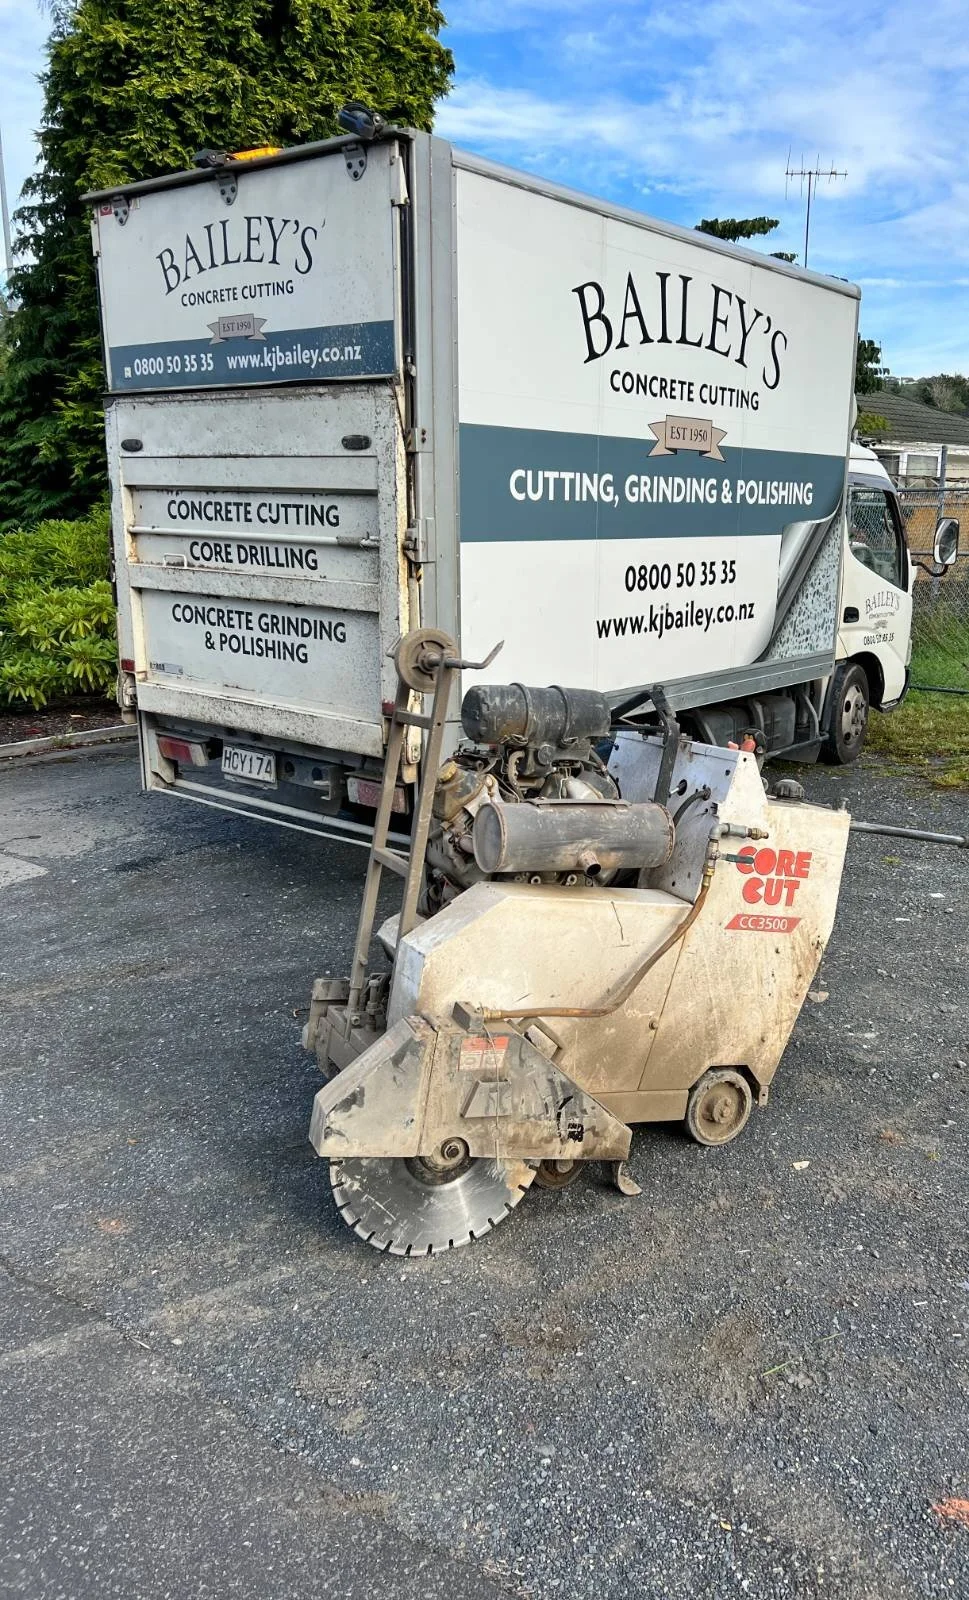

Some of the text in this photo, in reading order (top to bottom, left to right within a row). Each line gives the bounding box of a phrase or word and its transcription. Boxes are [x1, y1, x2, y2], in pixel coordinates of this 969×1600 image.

[156, 216, 318, 296] BAILEY'S
[181, 279, 294, 307] CONCRETE CUTTING
[222, 320, 252, 333] EST 1950
[572, 271, 788, 390] BAILEY'S
[134, 353, 214, 376] 0800 50 35 35
[227, 344, 362, 371] www.kjbailey.co.nz
[610, 369, 760, 411] CONCRETE CUTTING
[670, 425, 708, 443] EST 1950
[509, 469, 814, 508] CUTTING, GRINDING & POLISHING
[167, 500, 340, 528] CONCRETE CUTTING
[189, 541, 318, 571] CORE DRILLING
[625, 560, 737, 592] 0800 50 35 35
[171, 603, 347, 643] CONCRETE GRINDING
[596, 600, 755, 640] www.kjbailey.co.nz
[204, 631, 309, 664] & POLISHING
[223, 749, 273, 776] HCY174
[736, 846, 812, 878] CORE
[742, 877, 800, 907] CUT
[740, 916, 788, 932] CC3500
